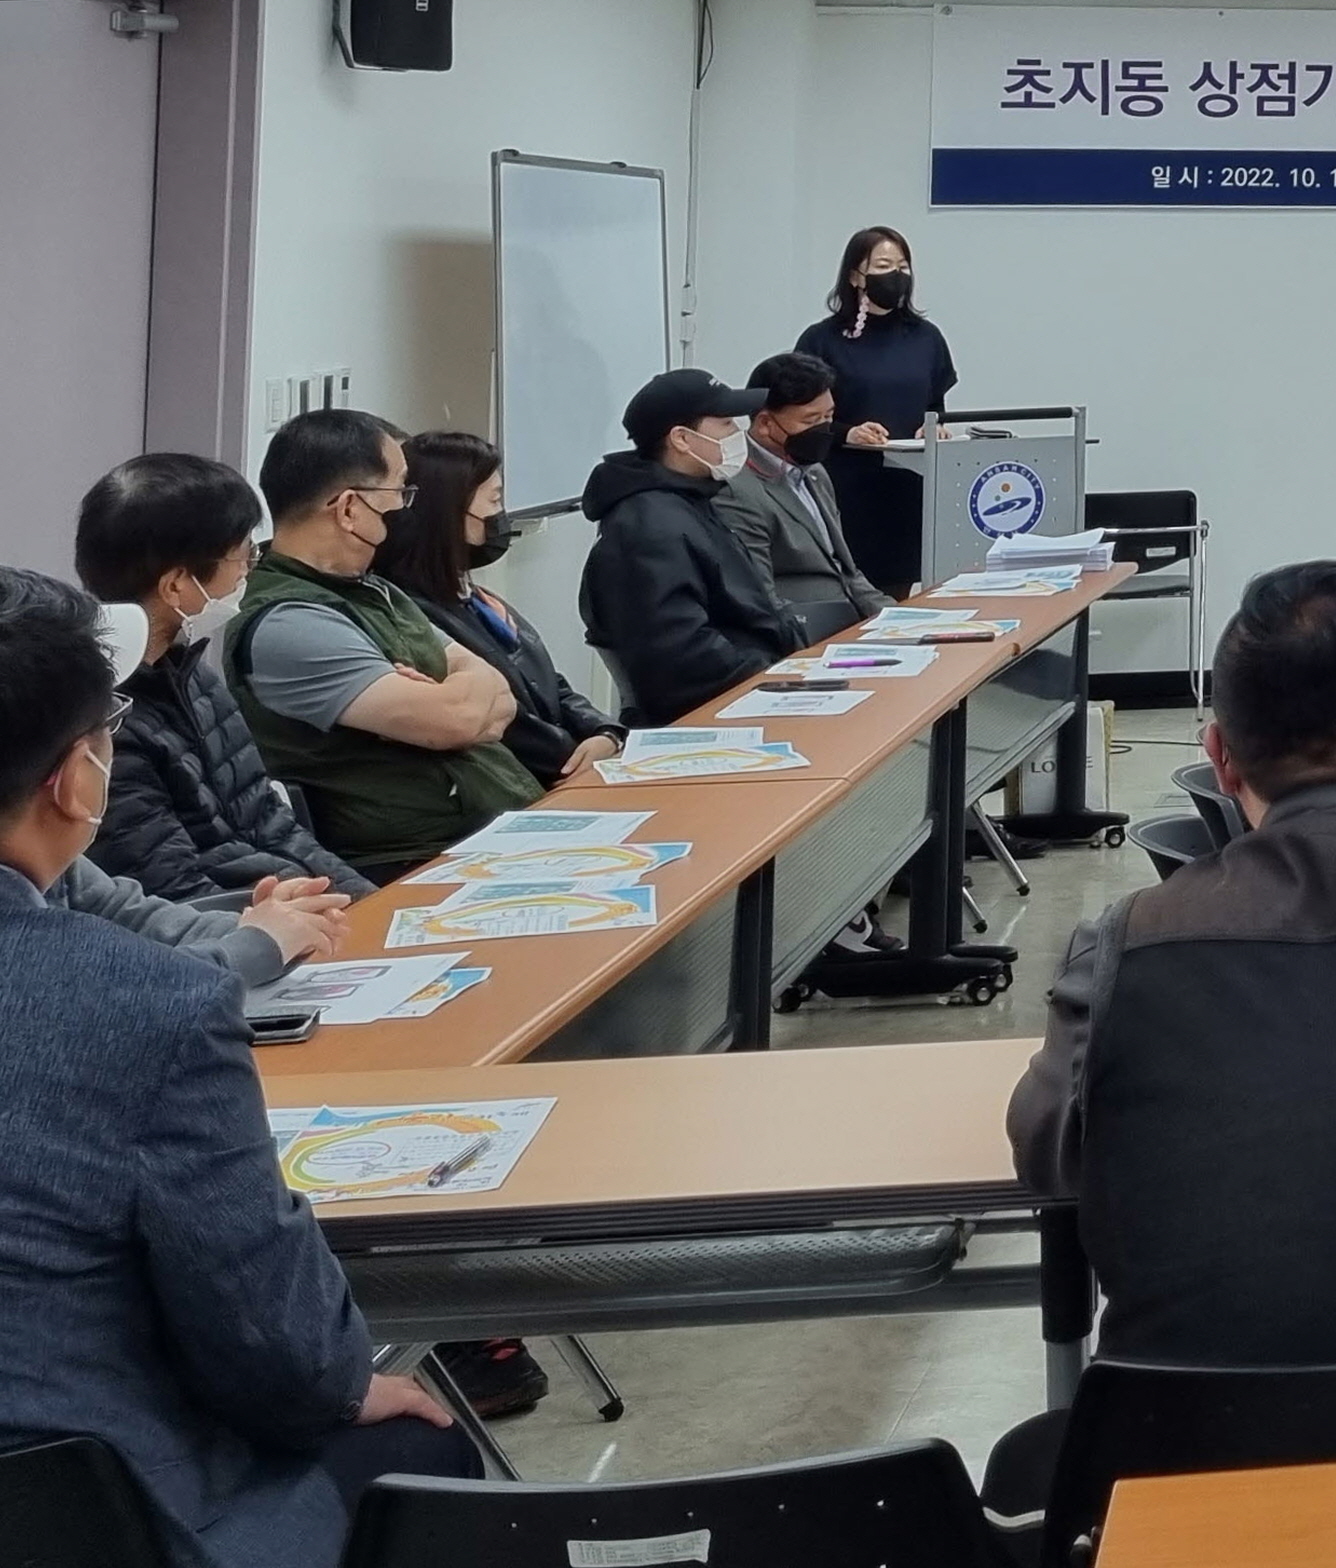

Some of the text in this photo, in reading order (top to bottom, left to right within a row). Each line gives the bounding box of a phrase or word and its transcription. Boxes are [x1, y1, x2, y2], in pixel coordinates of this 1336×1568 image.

[1000, 58, 1169, 118] 초지동
[1151, 165, 1171, 189] 일
[1178, 166, 1199, 189] 시
[1220, 167, 1280, 189] 2022.
[1289, 168, 1321, 188] 10.
